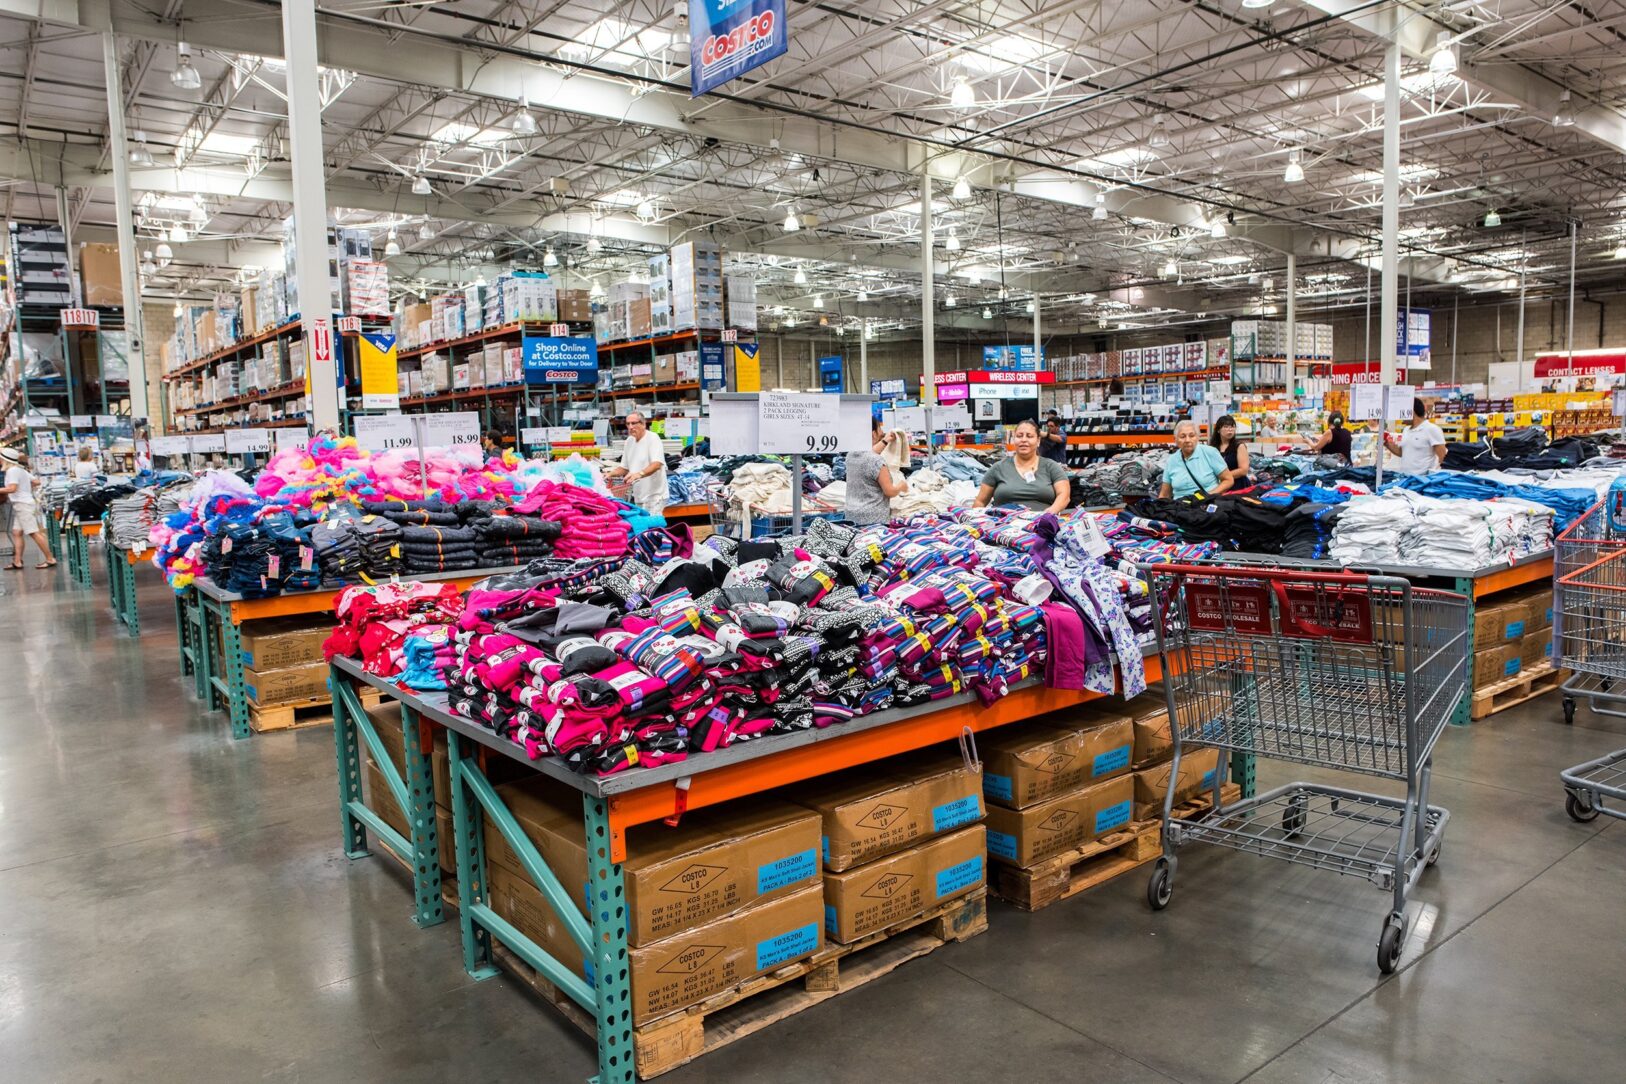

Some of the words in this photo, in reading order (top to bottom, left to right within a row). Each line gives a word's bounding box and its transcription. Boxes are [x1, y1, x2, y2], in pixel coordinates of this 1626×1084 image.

[702, 10, 775, 65] COSTCO
[341, 318, 354, 330] 116
[552, 325, 566, 336] 114
[724, 331, 736, 340] 112
[536, 343, 558, 354] Shop
[561, 344, 586, 352] Online
[542, 352, 590, 360] Costco.com
[546, 370, 578, 378] COSTCO
[946, 372, 966, 382] CENTER
[989, 373, 1015, 381] WIRELESS
[1016, 373, 1036, 381] CENTER
[1352, 373, 1366, 383] AID
[1548, 368, 1583, 376] CONTACT
[1368, 408, 1382, 418] 14.99
[384, 438, 411, 448] 11.99
[452, 434, 478, 444] 18.99
[806, 435, 838, 452] 9.99
[945, 800, 967, 812] 1035200
[873, 808, 892, 820] COSTCO
[775, 856, 802, 870] 1035200
[682, 869, 707, 883] COSTCO
[763, 882, 778, 891] PACK
[878, 877, 897, 889] COSTCO
[652, 907, 663, 916] GW
[667, 902, 682, 910] 16.65
[687, 896, 700, 904] KGS
[704, 890, 718, 899] 36.70
[725, 883, 736, 892] LBS
[652, 915, 663, 924] NW
[666, 910, 681, 919] 14.17
[687, 904, 700, 912] KGS
[704, 898, 718, 908] 31.25
[724, 892, 735, 900] LBS
[652, 922, 671, 932] MEAS:
[726, 897, 740, 907] INCH
[774, 932, 802, 947] 1035200
[802, 937, 815, 945] Jacket
[680, 949, 704, 964] COSTCO
[762, 959, 778, 968] PACK
[648, 989, 660, 998] GW
[663, 983, 678, 992] 16.54
[684, 975, 698, 984] KGS
[700, 969, 714, 979] 36.47
[723, 961, 735, 970] LBS
[649, 997, 659, 1006] NW
[663, 991, 678, 1001] 14.07
[684, 983, 697, 992] KGS
[700, 977, 715, 986] 31.02
[722, 969, 734, 978] LBS
[649, 1004, 670, 1013] MEAS:
[725, 975, 739, 985] INCH
